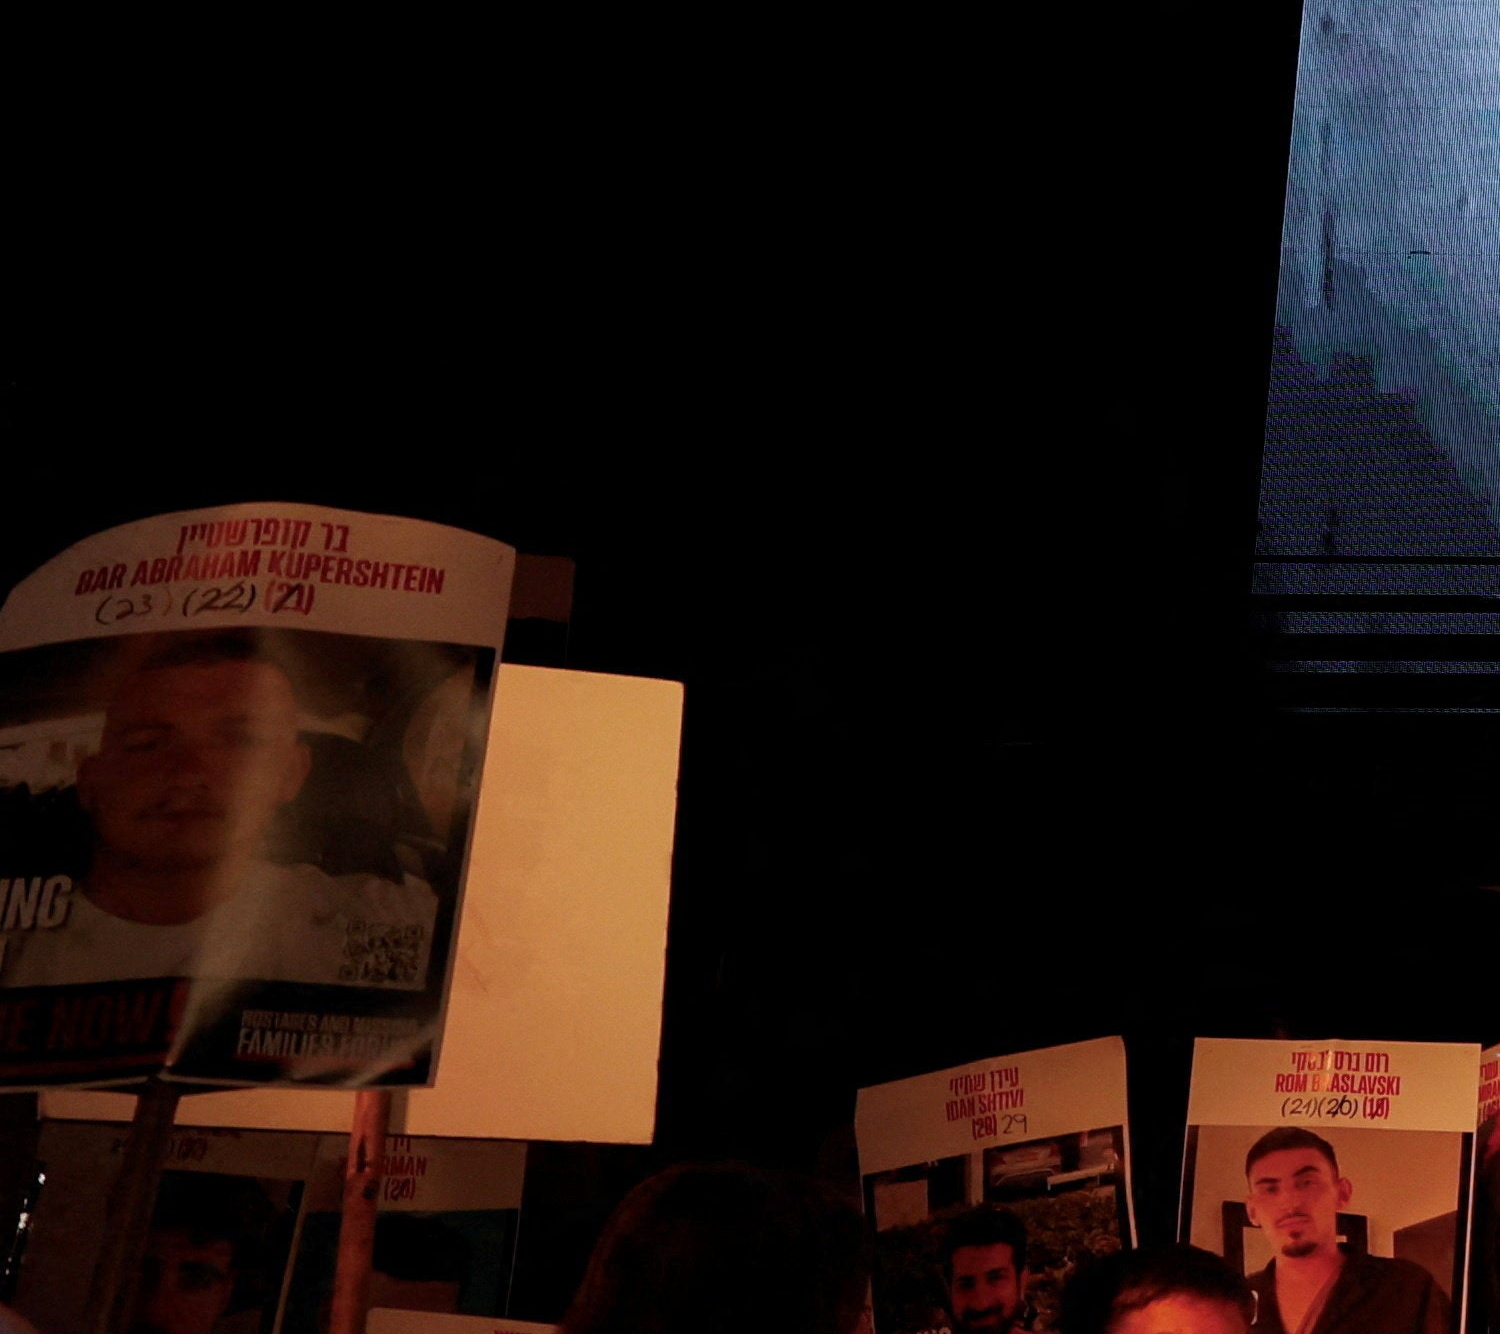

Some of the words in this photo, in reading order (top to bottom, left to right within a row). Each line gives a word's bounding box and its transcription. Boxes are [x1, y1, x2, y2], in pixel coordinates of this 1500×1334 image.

[177, 519, 310, 552] קופרשטיין
[75, 564, 125, 595] BAR
[131, 551, 261, 589] ABRAHAM
[268, 553, 444, 594] KUPERSHTEIN
[1275, 1073, 1308, 1096] ROM
[1311, 1075, 1401, 1097] BASLAVSKI
[946, 1098, 976, 1124] IDAN
[1281, 1096, 1318, 1118] (21)
